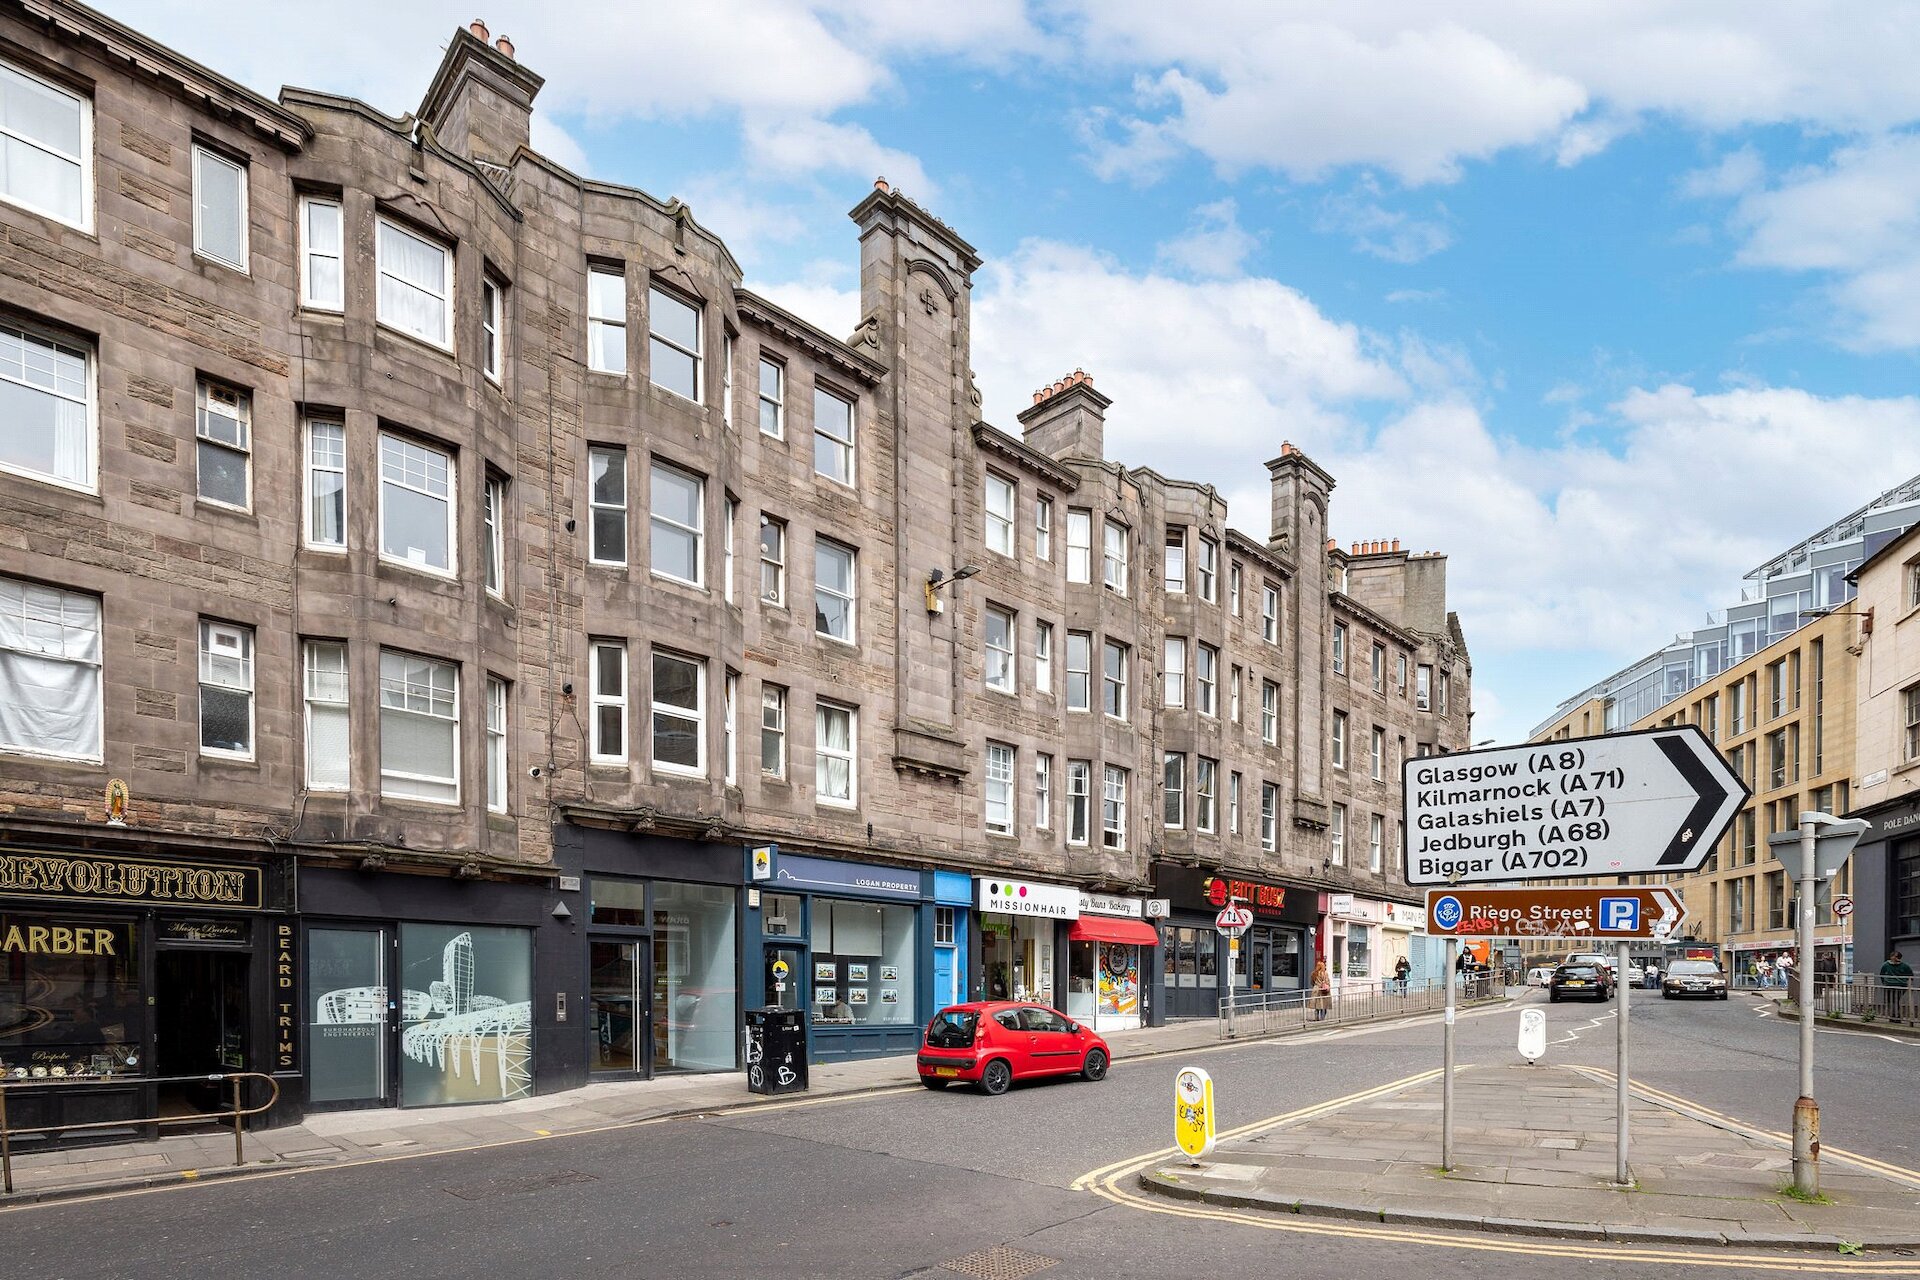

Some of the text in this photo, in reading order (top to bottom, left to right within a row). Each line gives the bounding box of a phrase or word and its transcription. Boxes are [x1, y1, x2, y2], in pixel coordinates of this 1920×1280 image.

[1417, 748, 1585, 785] Glasgow (A8)
[1417, 767, 1625, 808] Kilmarnock (A71)
[1417, 795, 1605, 830] Galashiels (A7)
[1883, 817, 1902, 831] POLE
[1418, 819, 1610, 853] Jedburgh (A68)
[1419, 846, 1588, 878] Biggar (A702)
[855, 878, 918, 891] LOGAN PROPERTY
[990, 899, 1067, 915] MISSIONHAIR
[1090, 897, 1106, 909] Buns
[1108, 899, 1131, 914] Bakery
[1470, 901, 1634, 927] Riego Street P
[0, 925, 116, 956] ARBER
[167, 921, 238, 934] Master Barbers
[278, 925, 292, 988] BEARD
[279, 1003, 293, 1066] TRIMS
